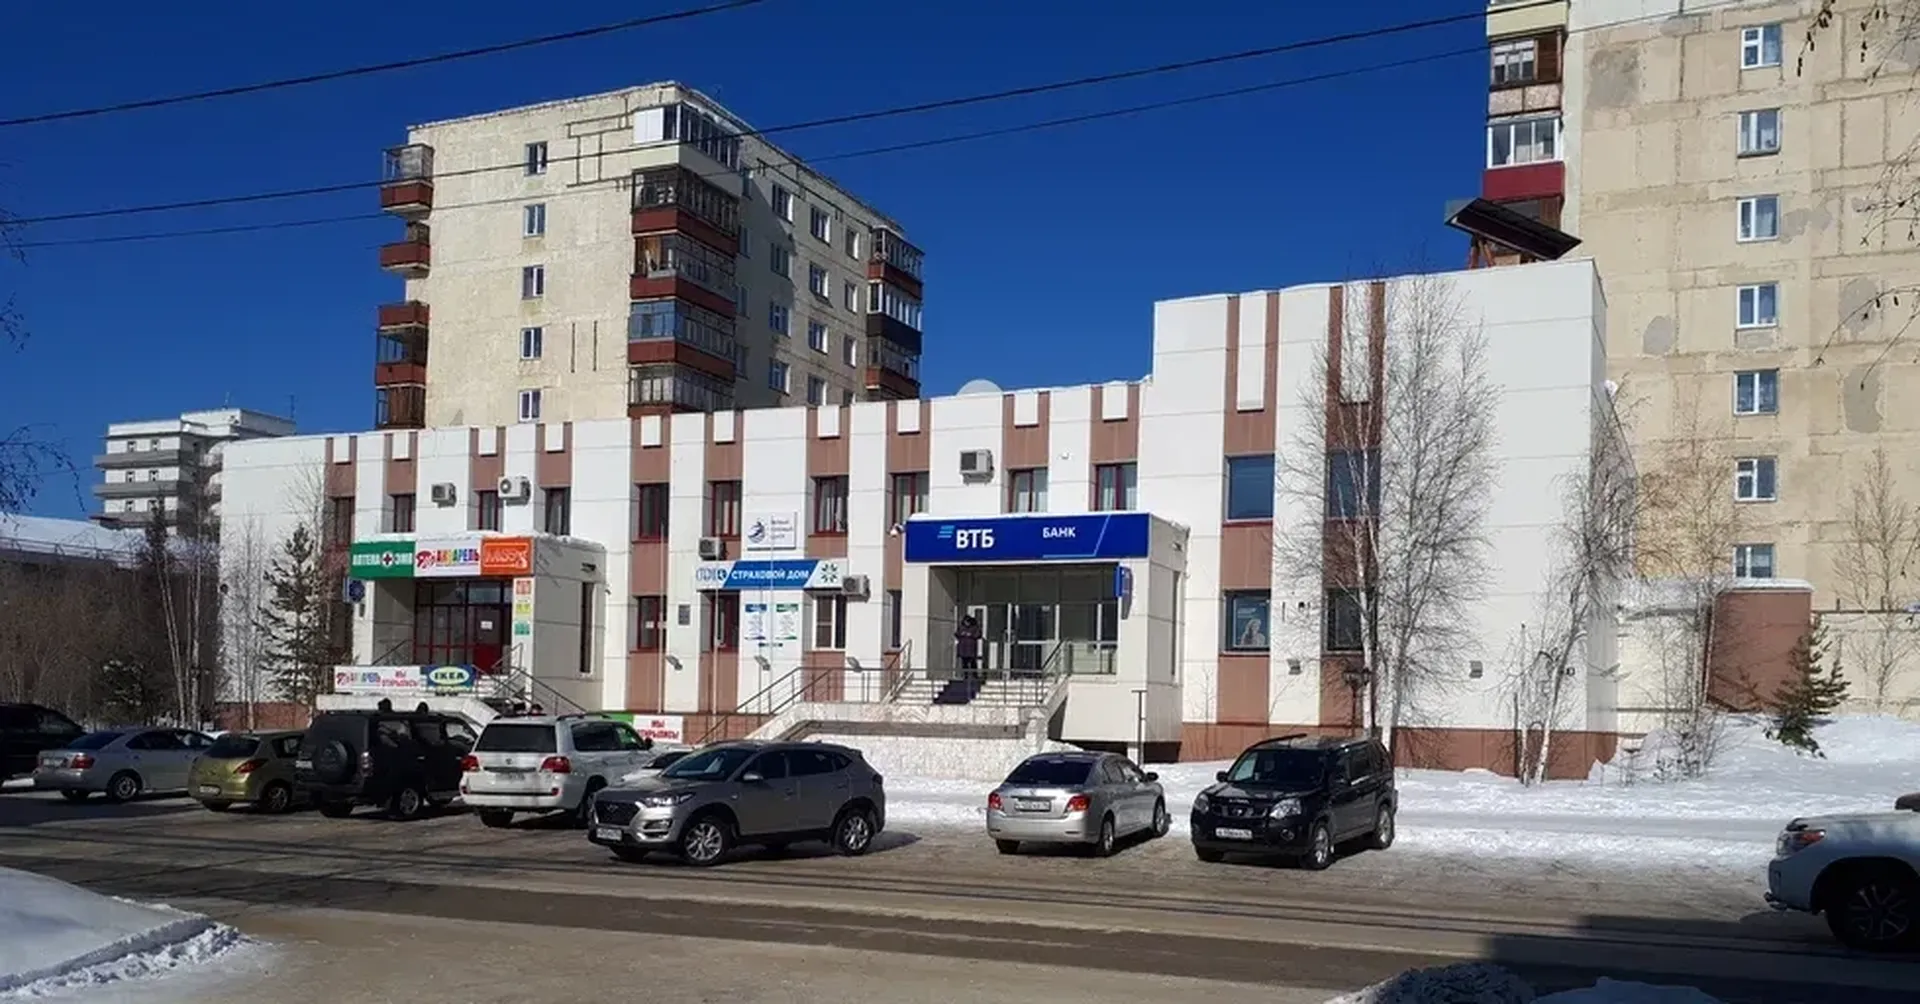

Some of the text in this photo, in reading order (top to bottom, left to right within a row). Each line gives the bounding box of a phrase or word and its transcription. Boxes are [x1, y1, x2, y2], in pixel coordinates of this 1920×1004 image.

[956, 529, 995, 549] ВТБ
[1042, 527, 1076, 538] БАНК
[352, 553, 381, 566] АПТЕКА
[436, 548, 479, 562] АКВАРЕЛЬ
[731, 568, 785, 580] СТРАХОВОЙ
[786, 569, 809, 581] ДОМ
[434, 672, 465, 680] IKEA
